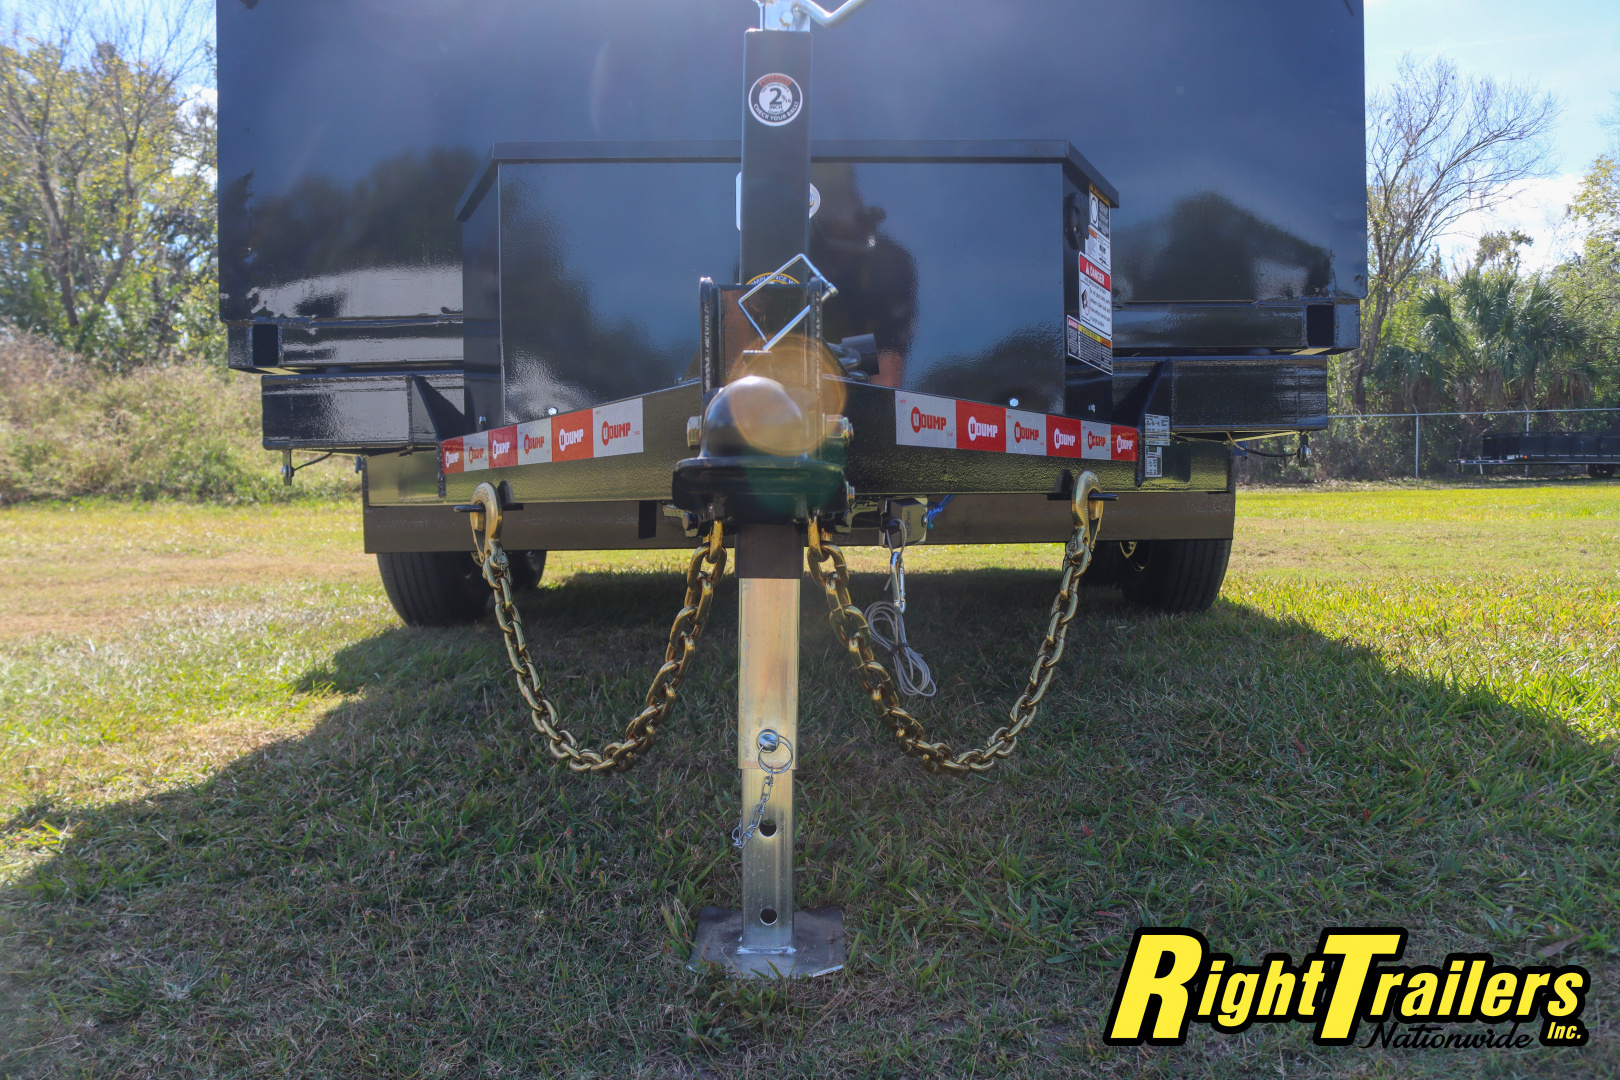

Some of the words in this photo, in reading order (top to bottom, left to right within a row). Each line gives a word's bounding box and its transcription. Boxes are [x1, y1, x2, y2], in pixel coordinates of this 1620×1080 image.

[769, 87, 782, 105] 2
[753, 103, 770, 120] CHECK
[1090, 265, 1105, 286] DANGER
